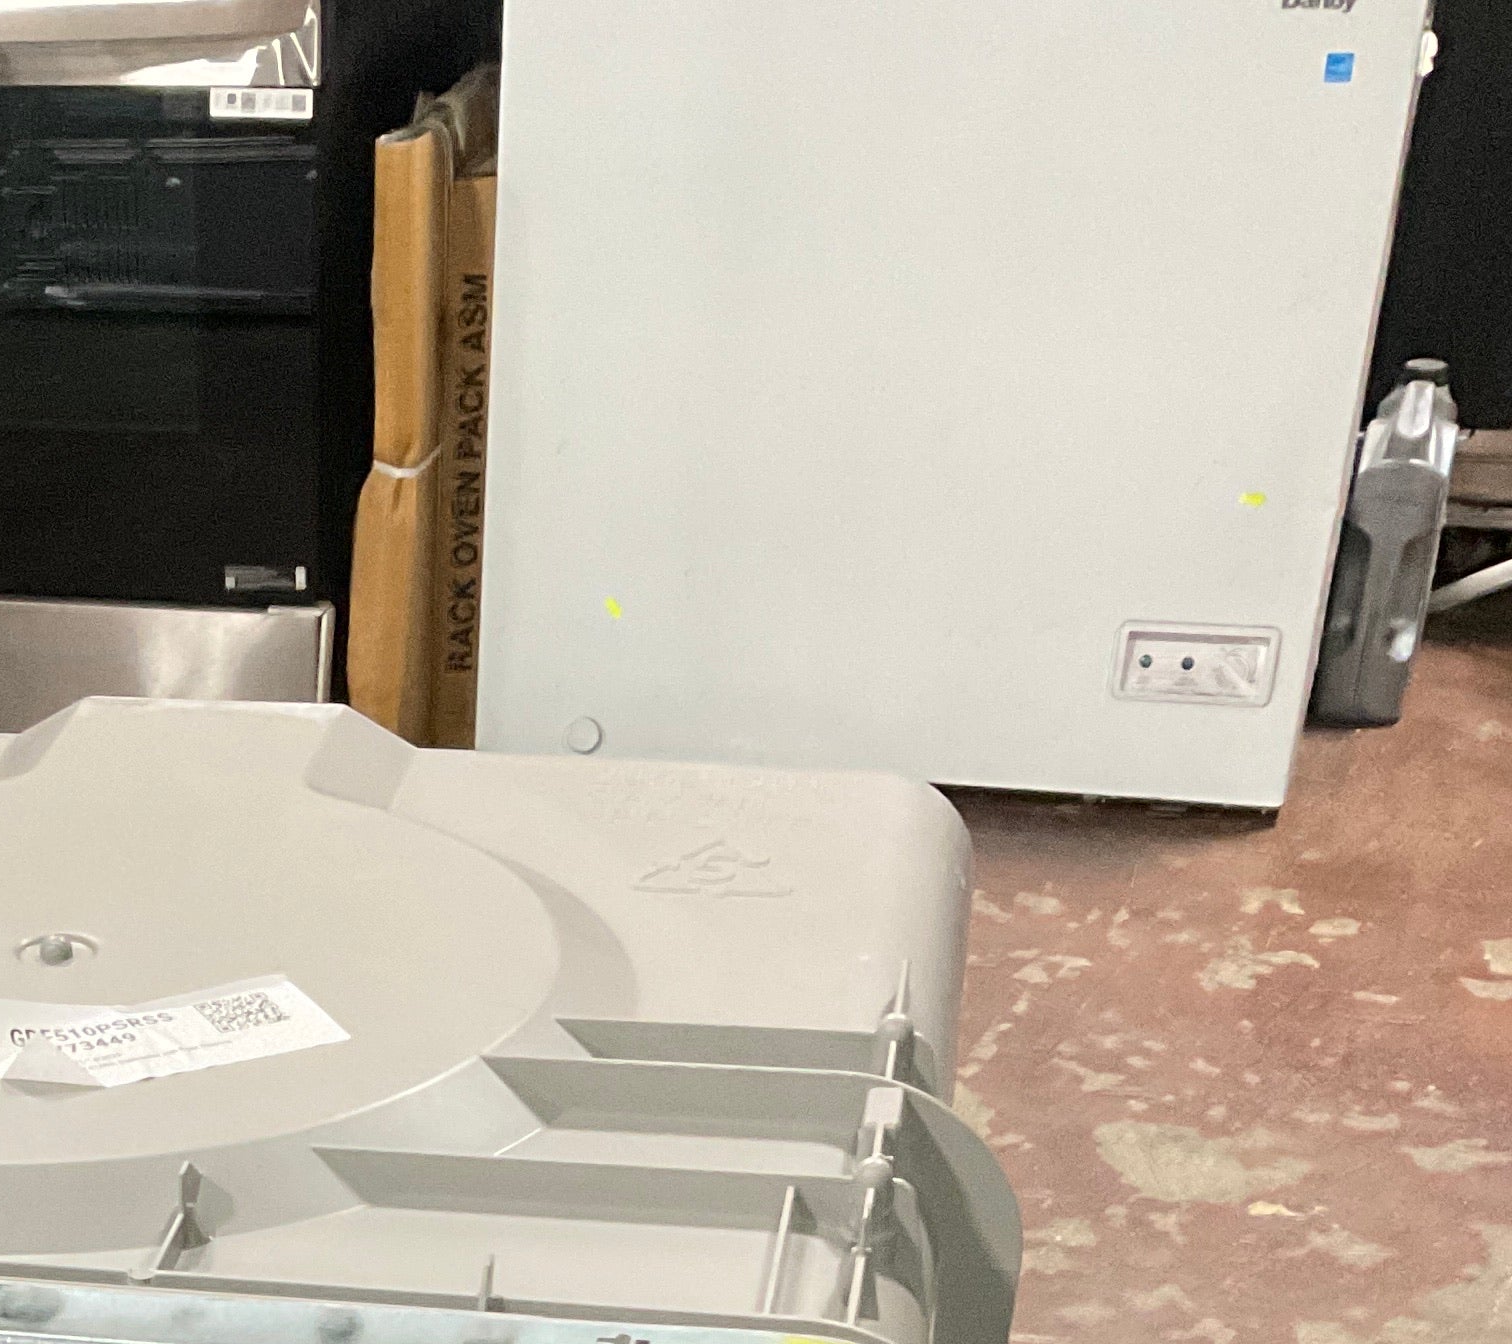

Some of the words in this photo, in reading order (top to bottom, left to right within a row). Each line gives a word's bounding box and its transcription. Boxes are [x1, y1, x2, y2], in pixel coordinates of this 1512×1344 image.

[457, 273, 488, 354] ASM
[455, 363, 487, 461] PACK
[452, 470, 482, 568] OVEN
[56, 1032, 138, 1054] 73449
